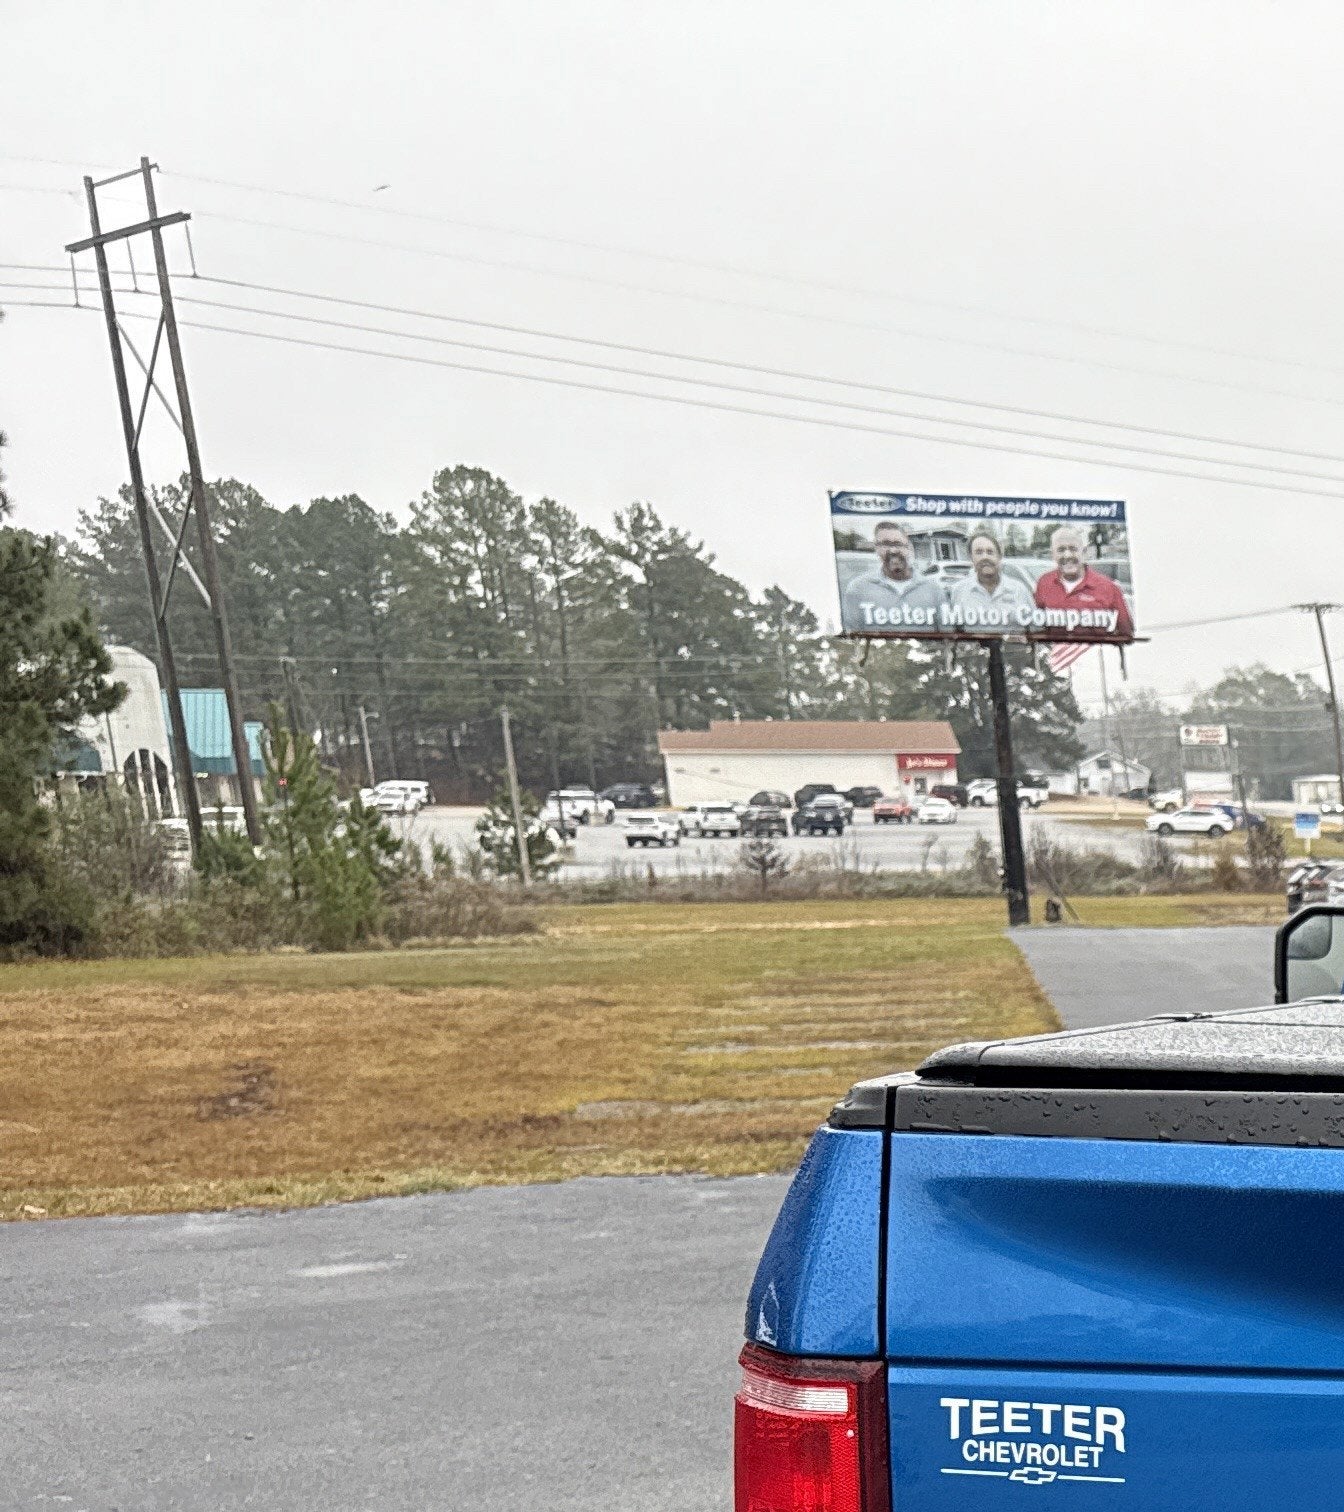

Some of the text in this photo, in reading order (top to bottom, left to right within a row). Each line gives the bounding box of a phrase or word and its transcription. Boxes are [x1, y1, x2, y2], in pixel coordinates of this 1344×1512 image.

[905, 496, 1118, 518] Shop with people you know!
[860, 602, 1119, 632] Teeter Motor Company
[940, 1397, 1126, 1453] TEETER
[962, 1439, 1104, 1468] CHEVROLET
